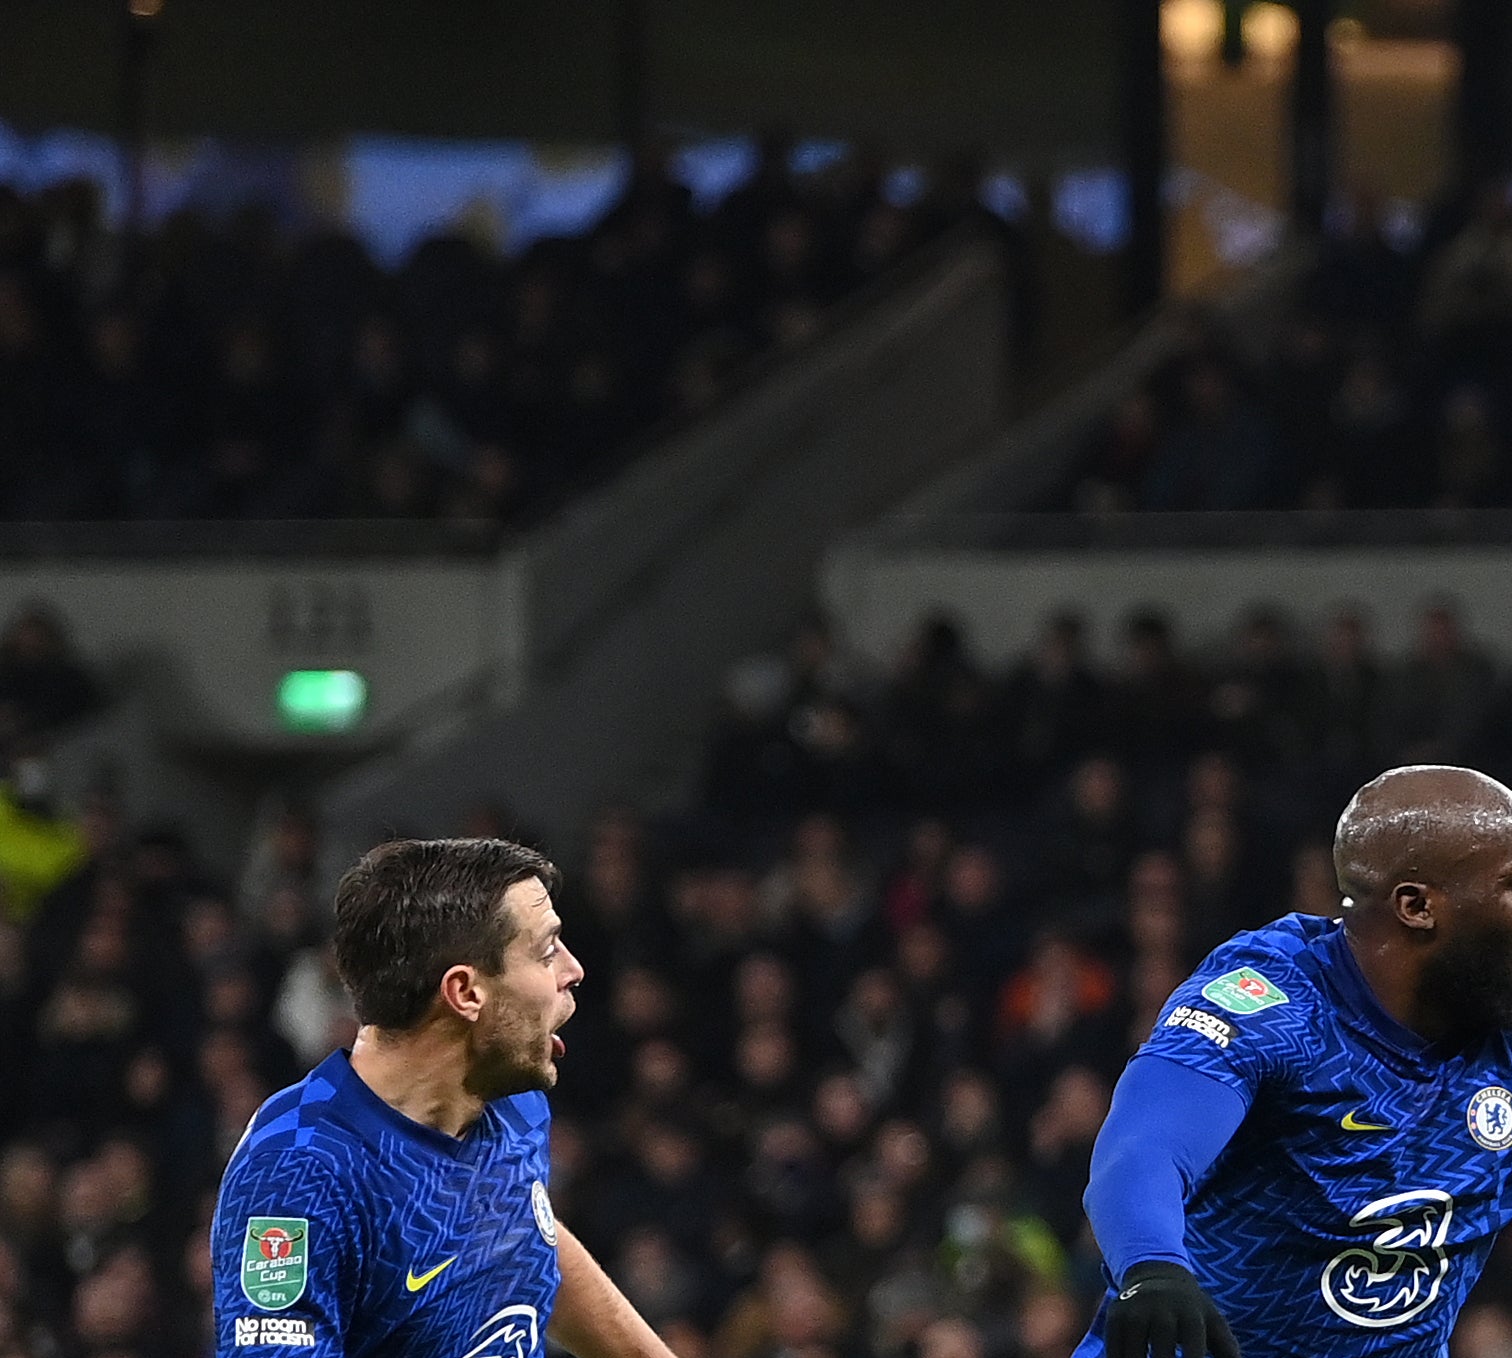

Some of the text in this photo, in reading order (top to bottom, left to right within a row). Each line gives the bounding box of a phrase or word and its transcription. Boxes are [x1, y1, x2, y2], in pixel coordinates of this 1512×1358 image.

[1190, 1009, 1230, 1035] room
[246, 1254, 303, 1273] Carabao
[260, 1269, 287, 1282] Cup
[235, 1317, 307, 1334] No room
[235, 1331, 315, 1348] for racism
